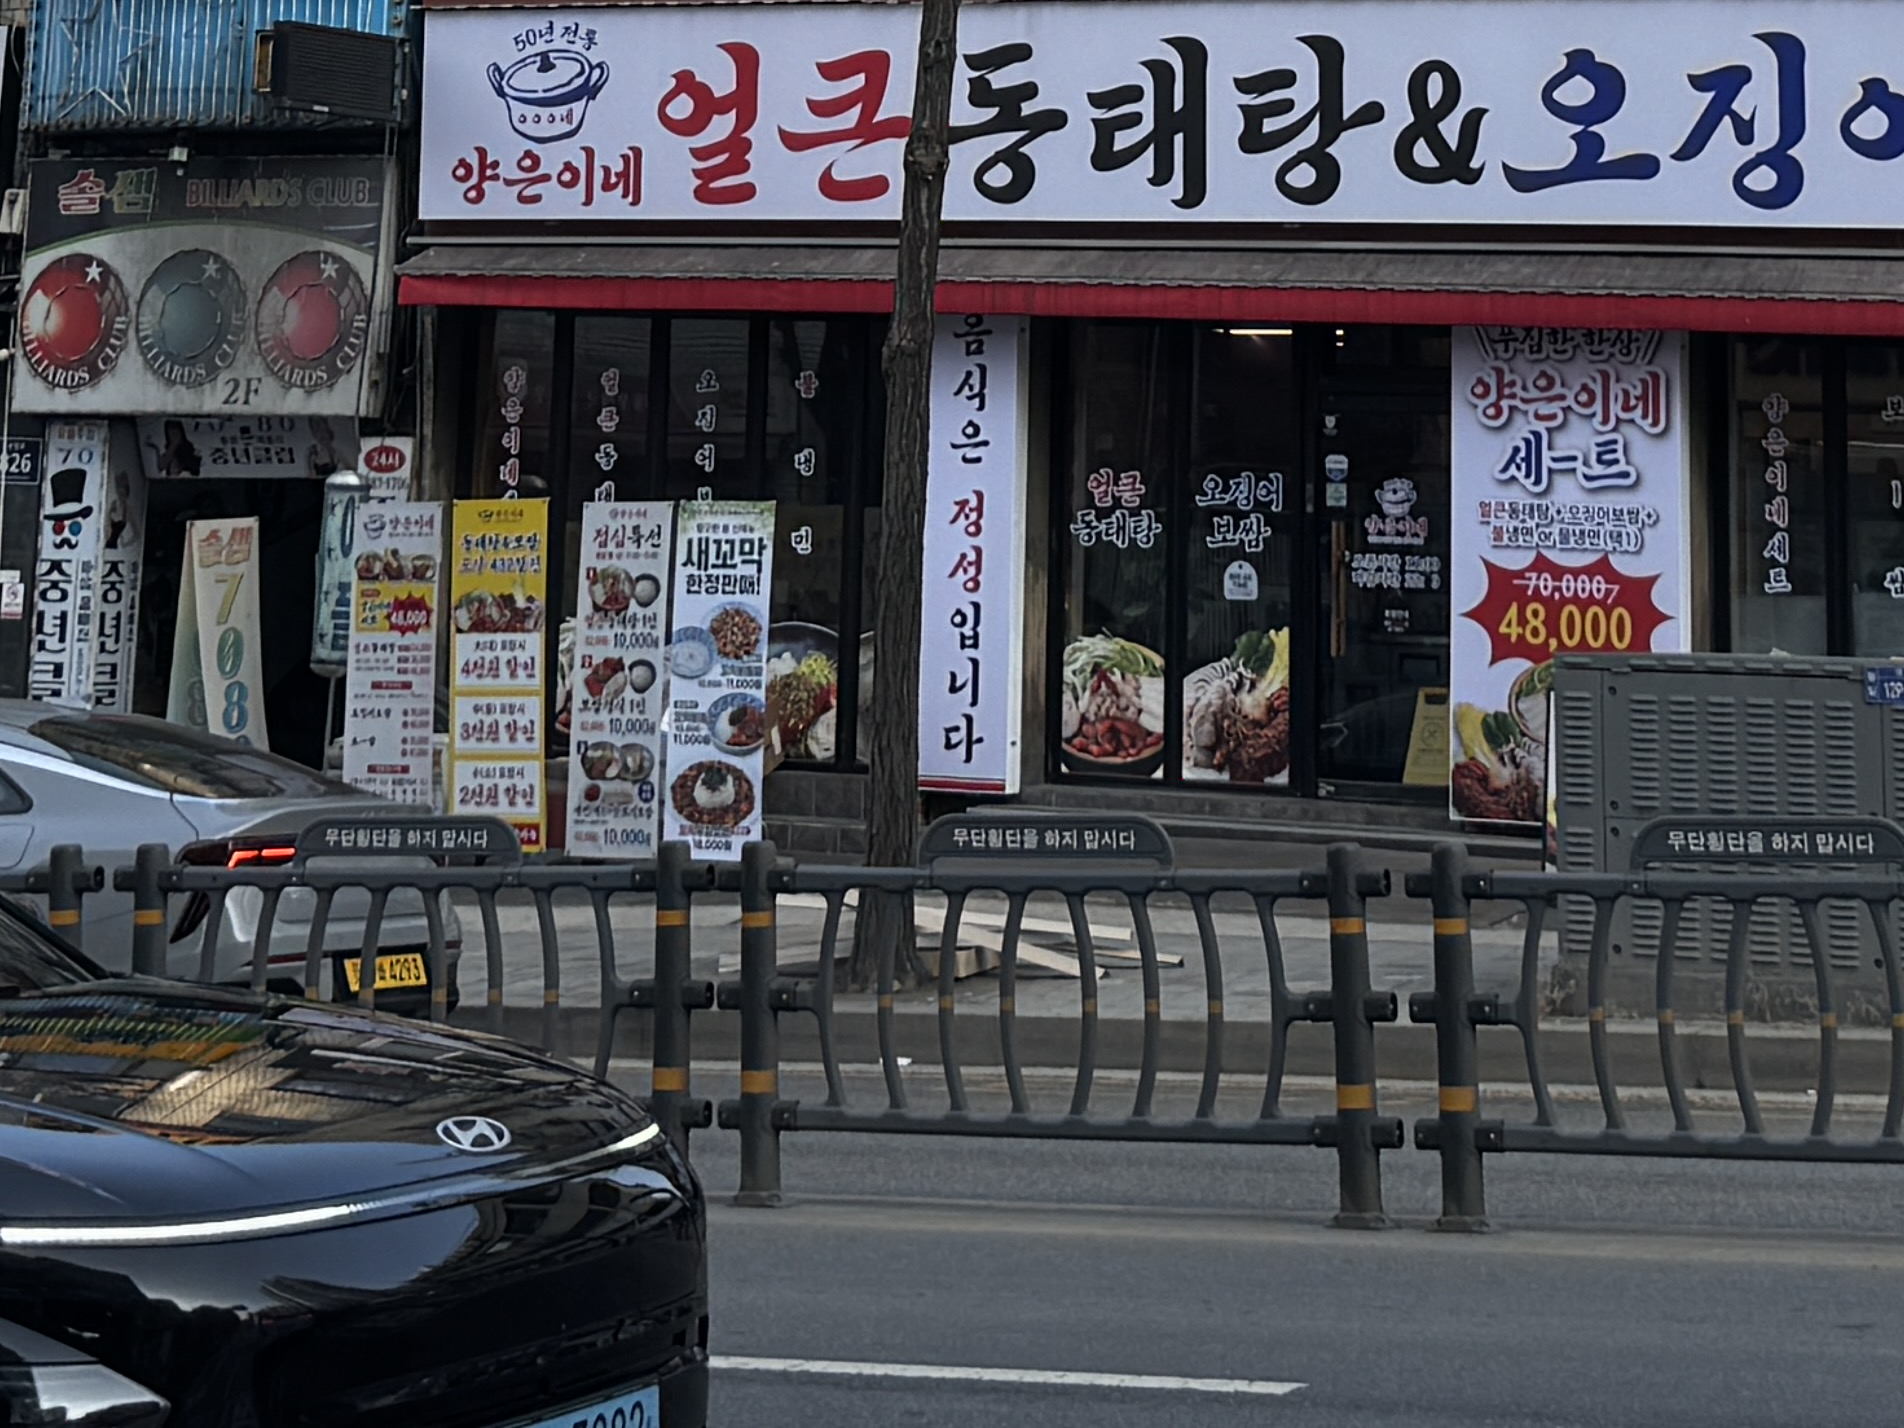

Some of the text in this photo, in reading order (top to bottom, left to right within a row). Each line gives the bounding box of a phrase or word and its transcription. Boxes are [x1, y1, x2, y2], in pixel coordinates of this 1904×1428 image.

[513, 19, 599, 51] 50년 전통
[449, 143, 644, 207] 양은이네
[306, 176, 370, 207] CLUB
[221, 376, 263, 406] 2F
[1468, 365, 1668, 435] 양은이네
[56, 446, 94, 465] 70
[1086, 467, 1146, 508] 얼큰
[1195, 471, 1284, 512] 오징어
[1069, 508, 1164, 548] 동태탕
[1205, 513, 1273, 553] 보쌈
[681, 535, 768, 574] 새꼬막
[686, 573, 761, 595] 한정판매!
[1524, 570, 1608, 602] 70,000
[942, 488, 987, 766] 정성입니다
[1498, 601, 1633, 652] 48,000
[504, 655, 537, 680] 할인
[504, 718, 537, 744] 할인
[504, 783, 537, 807] 할인
[323, 826, 489, 849] 무단횡단을 하지 맙시다
[952, 829, 1137, 851] 무단횡단을 하지 맙시다
[1666, 830, 1875, 855] 무단횡단을 하지 맙시다
